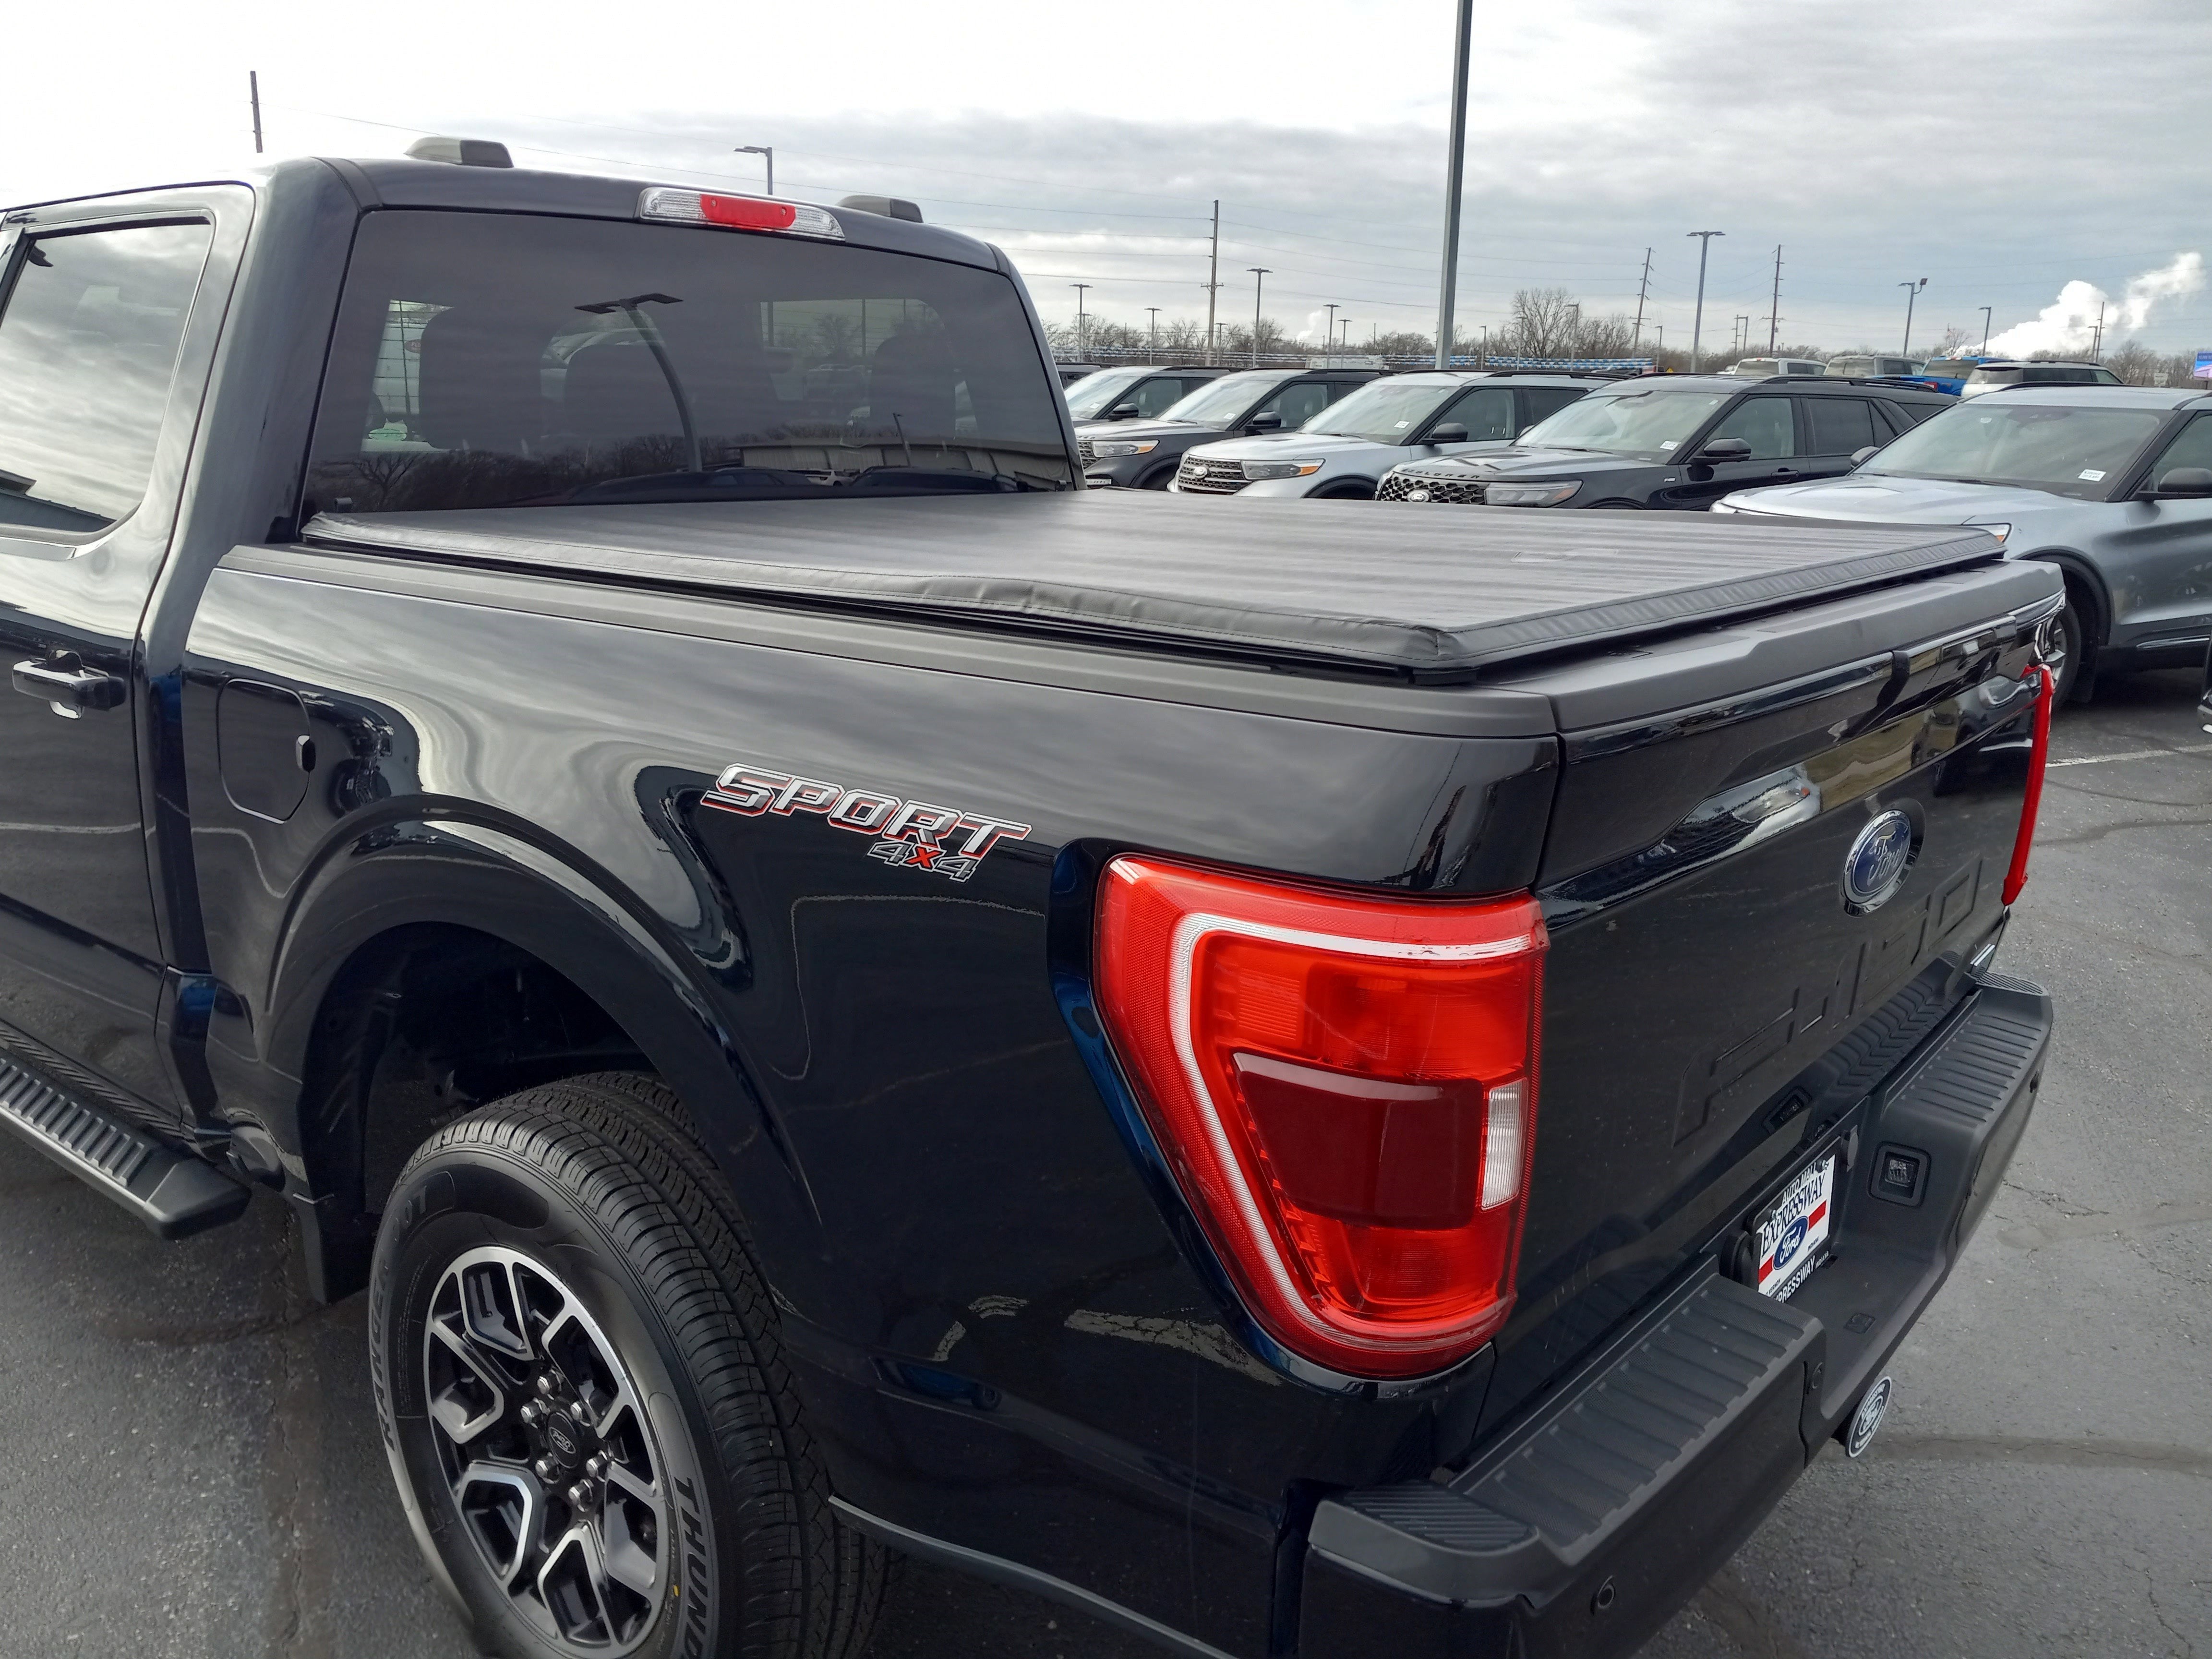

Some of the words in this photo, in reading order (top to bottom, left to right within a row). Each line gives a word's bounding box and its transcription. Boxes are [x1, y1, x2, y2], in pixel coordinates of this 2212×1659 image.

[700, 763, 1032, 859] SPORT
[1867, 830, 1903, 887] Ford
[1782, 1178, 1800, 1206] AUTO
[1801, 1162, 1818, 1187] MALL
[1761, 1172, 1826, 1257] EXPRESSWAY
[1779, 1226, 1802, 1263] Ford
[1776, 1255, 1816, 1304] PRESSWAY
[673, 1476, 709, 1659] THUND
